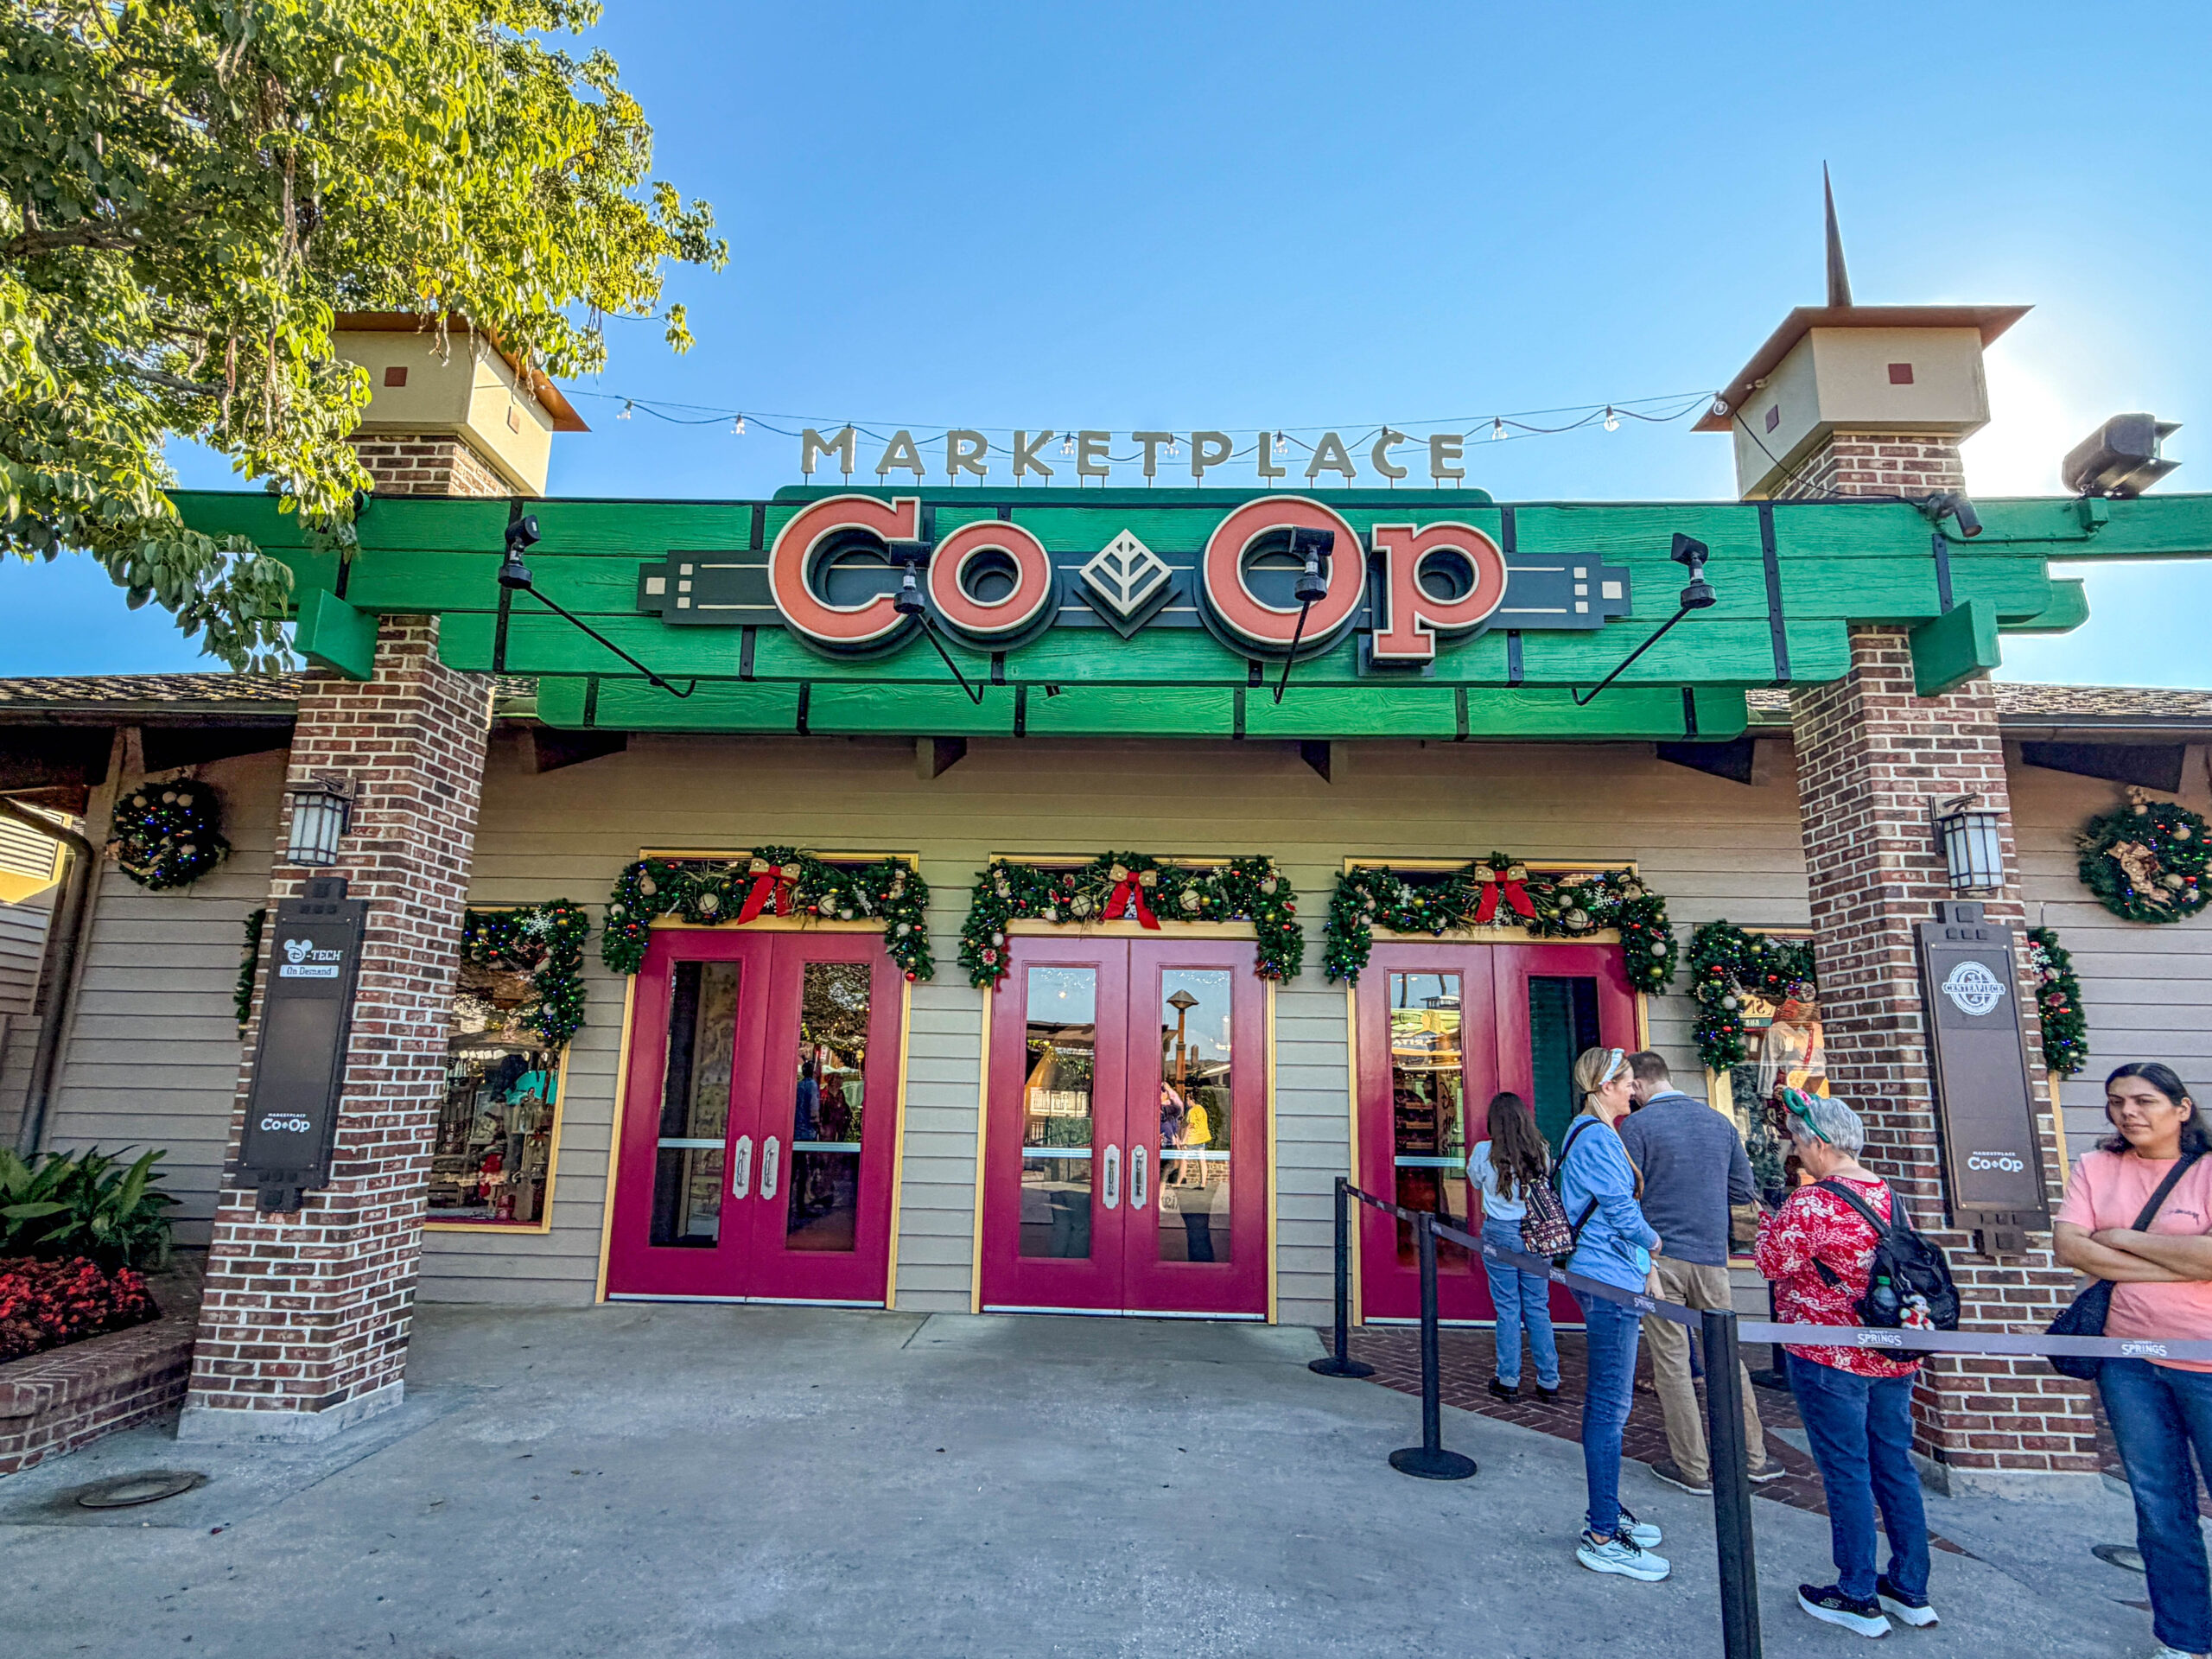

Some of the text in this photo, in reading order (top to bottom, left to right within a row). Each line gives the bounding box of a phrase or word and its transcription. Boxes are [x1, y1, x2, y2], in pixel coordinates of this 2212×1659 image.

[801, 428, 1465, 479] MARKETPLACE
[286, 966, 332, 976] On Demand
[1944, 982, 2005, 994] CENTERPIECE
[1858, 1332, 1903, 1346] SPRINGS
[2121, 1344, 2168, 1357] SPRINGS
